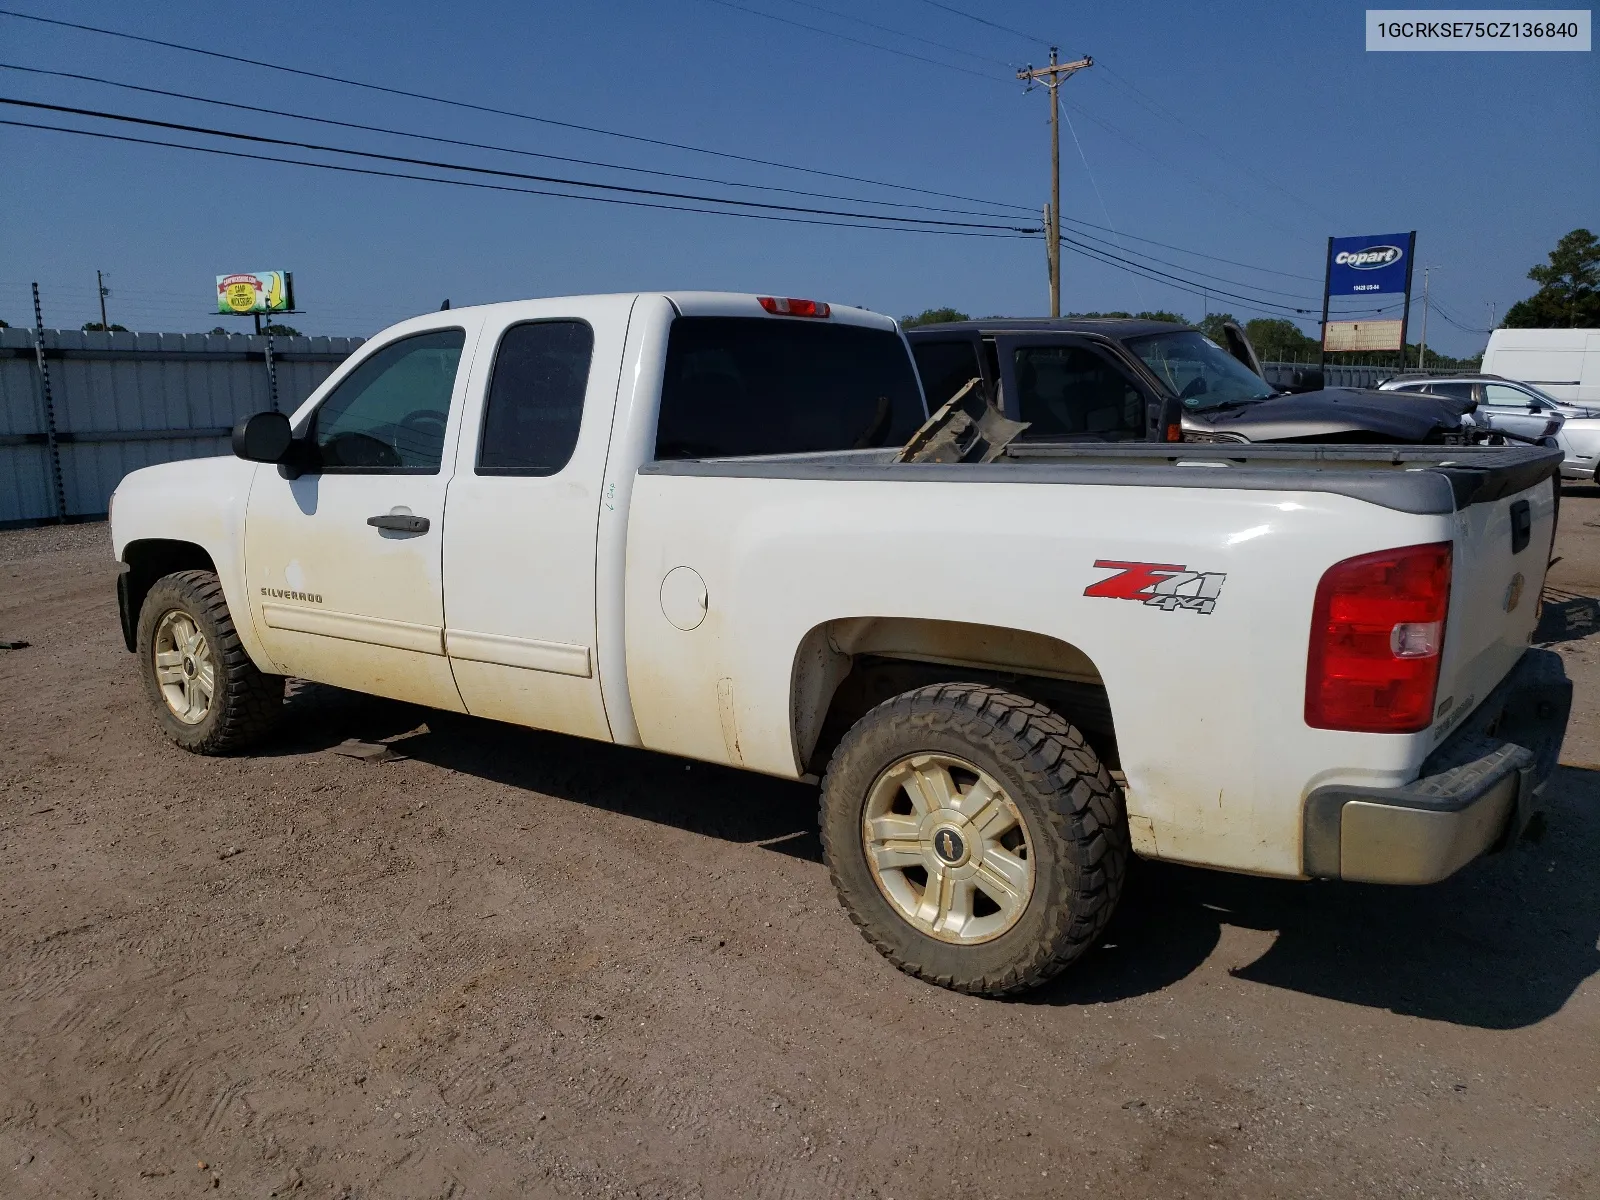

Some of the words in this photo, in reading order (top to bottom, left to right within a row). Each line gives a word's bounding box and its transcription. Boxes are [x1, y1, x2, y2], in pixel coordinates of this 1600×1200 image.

[1335, 248, 1395, 266] Copart
[1083, 559, 1228, 602] Z71
[261, 587, 323, 604] SILVERADO
